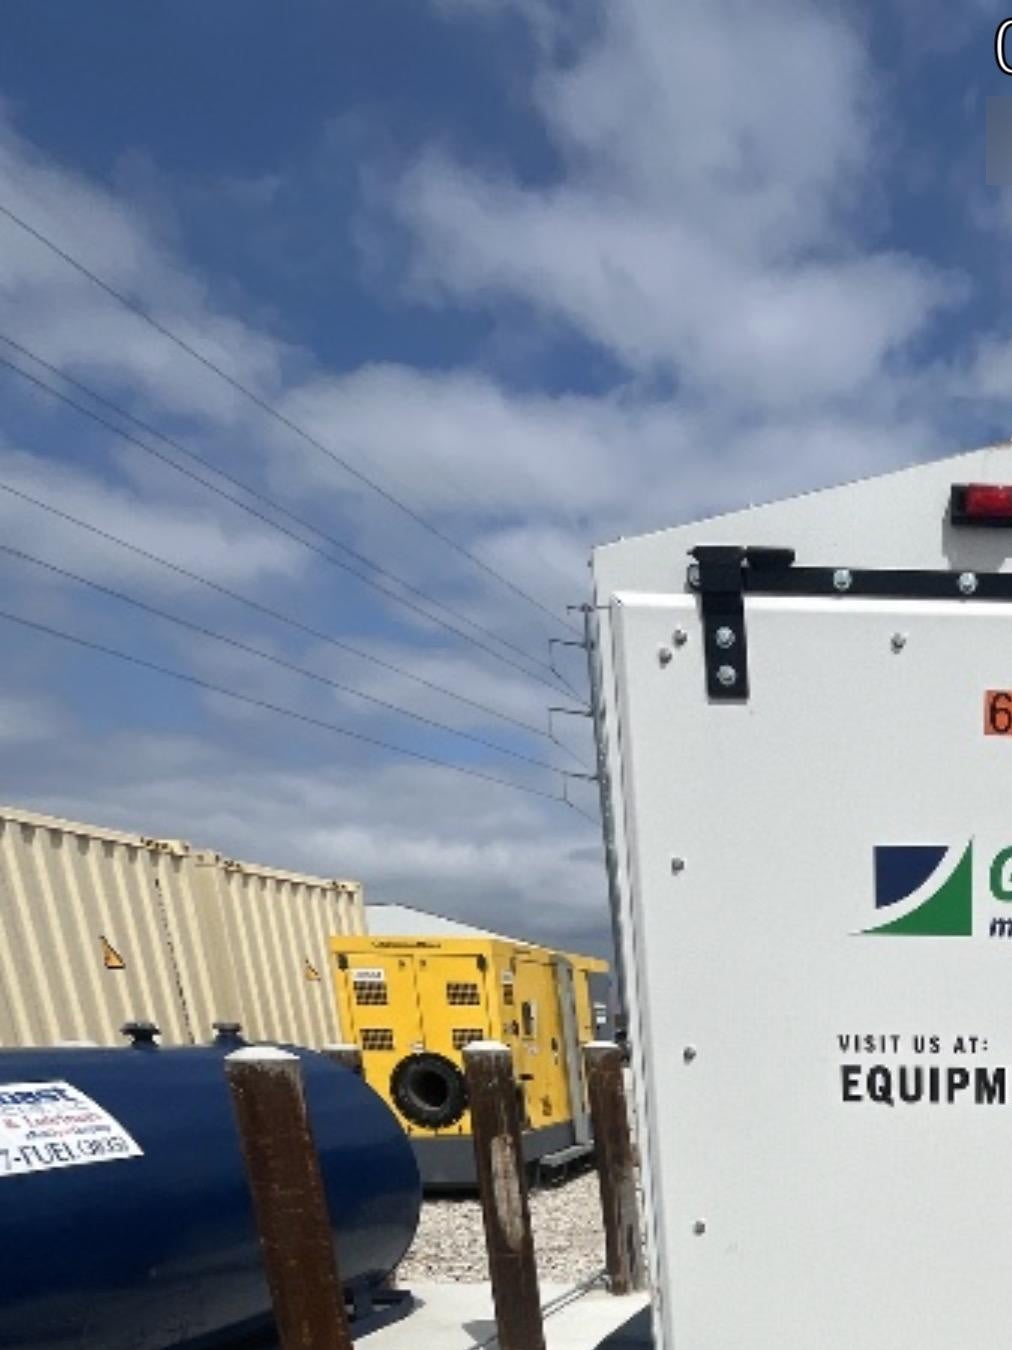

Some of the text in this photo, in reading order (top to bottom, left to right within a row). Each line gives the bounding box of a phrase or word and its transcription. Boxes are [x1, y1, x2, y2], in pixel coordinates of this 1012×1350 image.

[837, 1034, 990, 1055] VISIT US AT:
